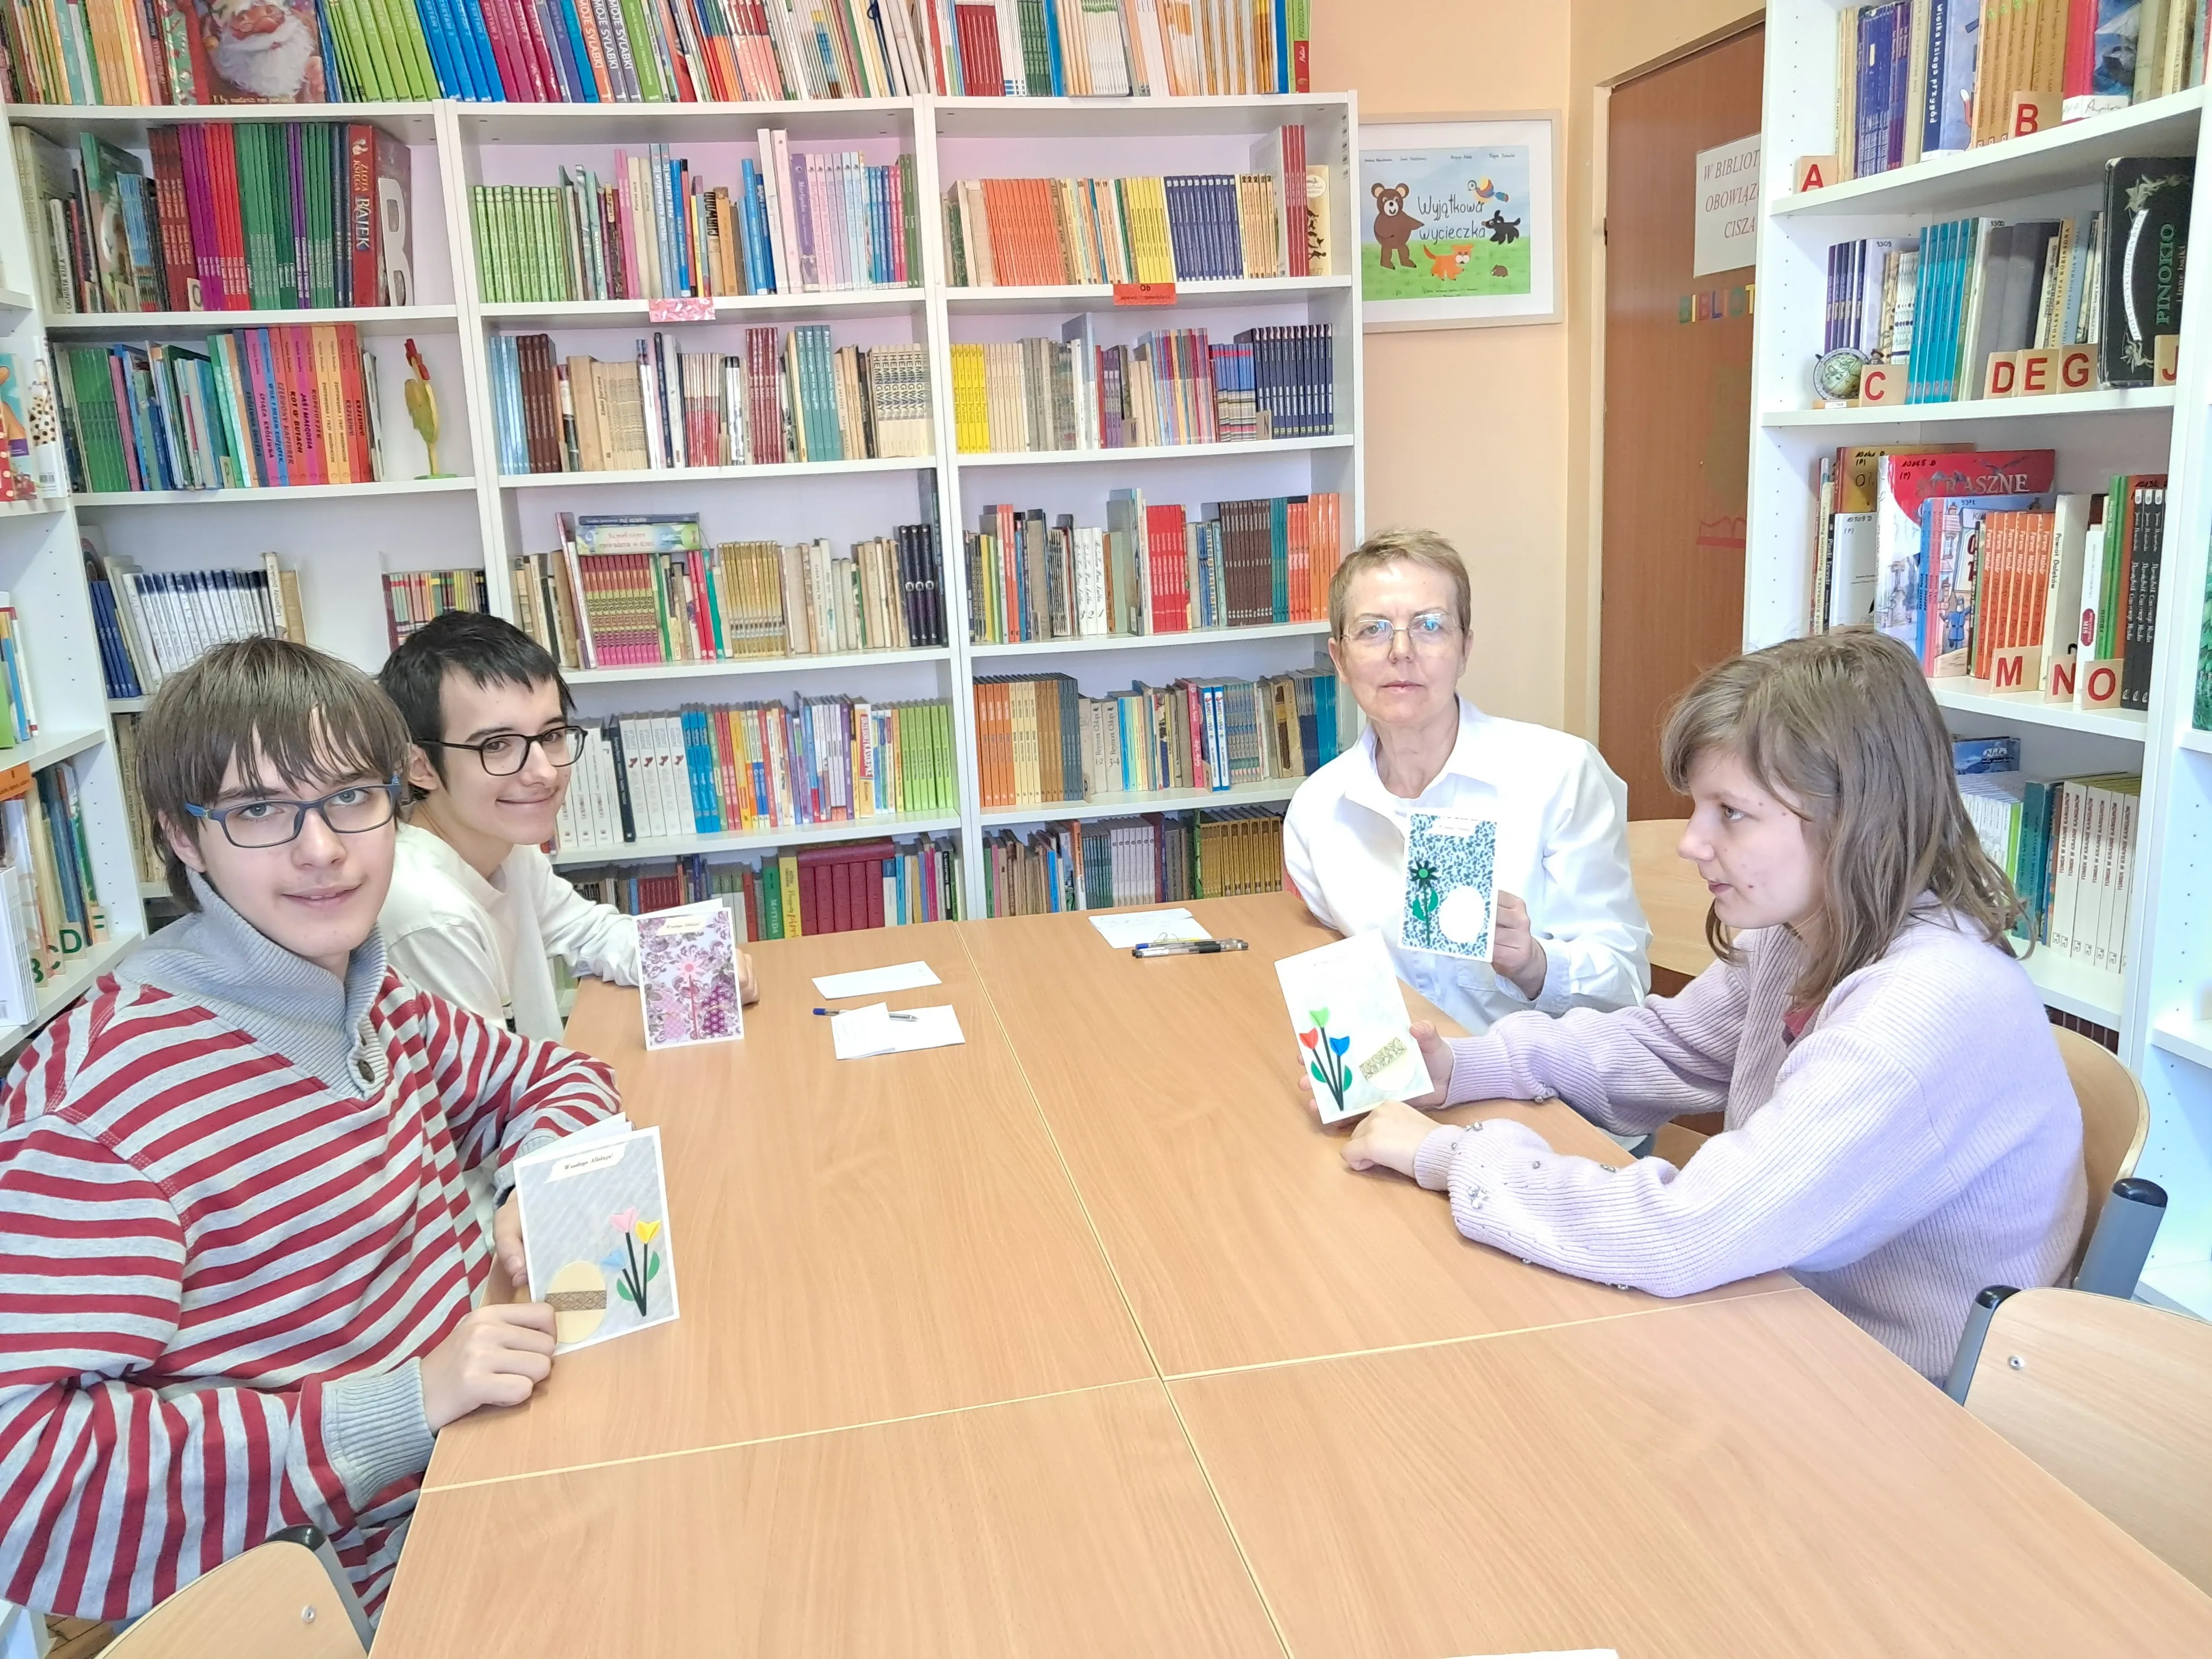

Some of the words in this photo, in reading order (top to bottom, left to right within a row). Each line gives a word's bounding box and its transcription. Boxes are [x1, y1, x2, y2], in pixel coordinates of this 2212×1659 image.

[1935, 4, 1944, 38] Wielka
[585, 28, 603, 68] SYLABKI
[601, 29, 619, 69] SYLABKI
[615, 29, 633, 69] SYLABKI
[1932, 41, 1943, 76] księga
[1928, 79, 1939, 124] przygód
[2015, 104, 2039, 137] B
[1703, 164, 1712, 182] W
[1801, 164, 1824, 192] A
[1418, 194, 1484, 221] Wyjątkowa
[1706, 183, 1759, 213] OBOWIĄZ
[354, 197, 370, 251] BAJEK
[1419, 220, 1486, 245] wycieczka
[1724, 216, 1755, 239] CISZA
[2055, 279, 2063, 305] WYSPA
[2059, 228, 2070, 275] ROBINSONA
[2124, 241, 2136, 310] ENCYKLOPEDIA
[2156, 224, 2174, 324] PINOKIO
[882, 355, 893, 411] HEMINGWAY
[890, 355, 901, 411] HEMINGWAY
[898, 355, 909, 410] HEMINGWAY
[906, 354, 916, 410] HEMINGWAY
[914, 353, 925, 409] HEMINGWAY
[1991, 361, 2015, 394] D
[2024, 358, 2048, 391] E
[2062, 352, 2089, 388] G
[2162, 345, 2178, 381] J
[873, 356, 885, 411] HEMINGWAY
[1864, 371, 1886, 401] C
[277, 382, 287, 422] CZERWONY
[284, 426, 294, 464] KAPTUREK
[290, 391, 298, 407] KOT
[294, 421, 303, 453] BUTACH
[303, 411, 313, 449] MAŁGOSIA
[311, 389, 322, 439] KOPCIUSZEK
[263, 422, 274, 458] KRÓLEWNA
[2041, 531, 2050, 551] Ferenc
[273, 589, 282, 617] Legendy
[1088, 610, 1095, 619] 2
[1996, 655, 2023, 687] M
[2052, 663, 2075, 696] N
[2087, 667, 2116, 702] O
[59, 929, 82, 954] D
